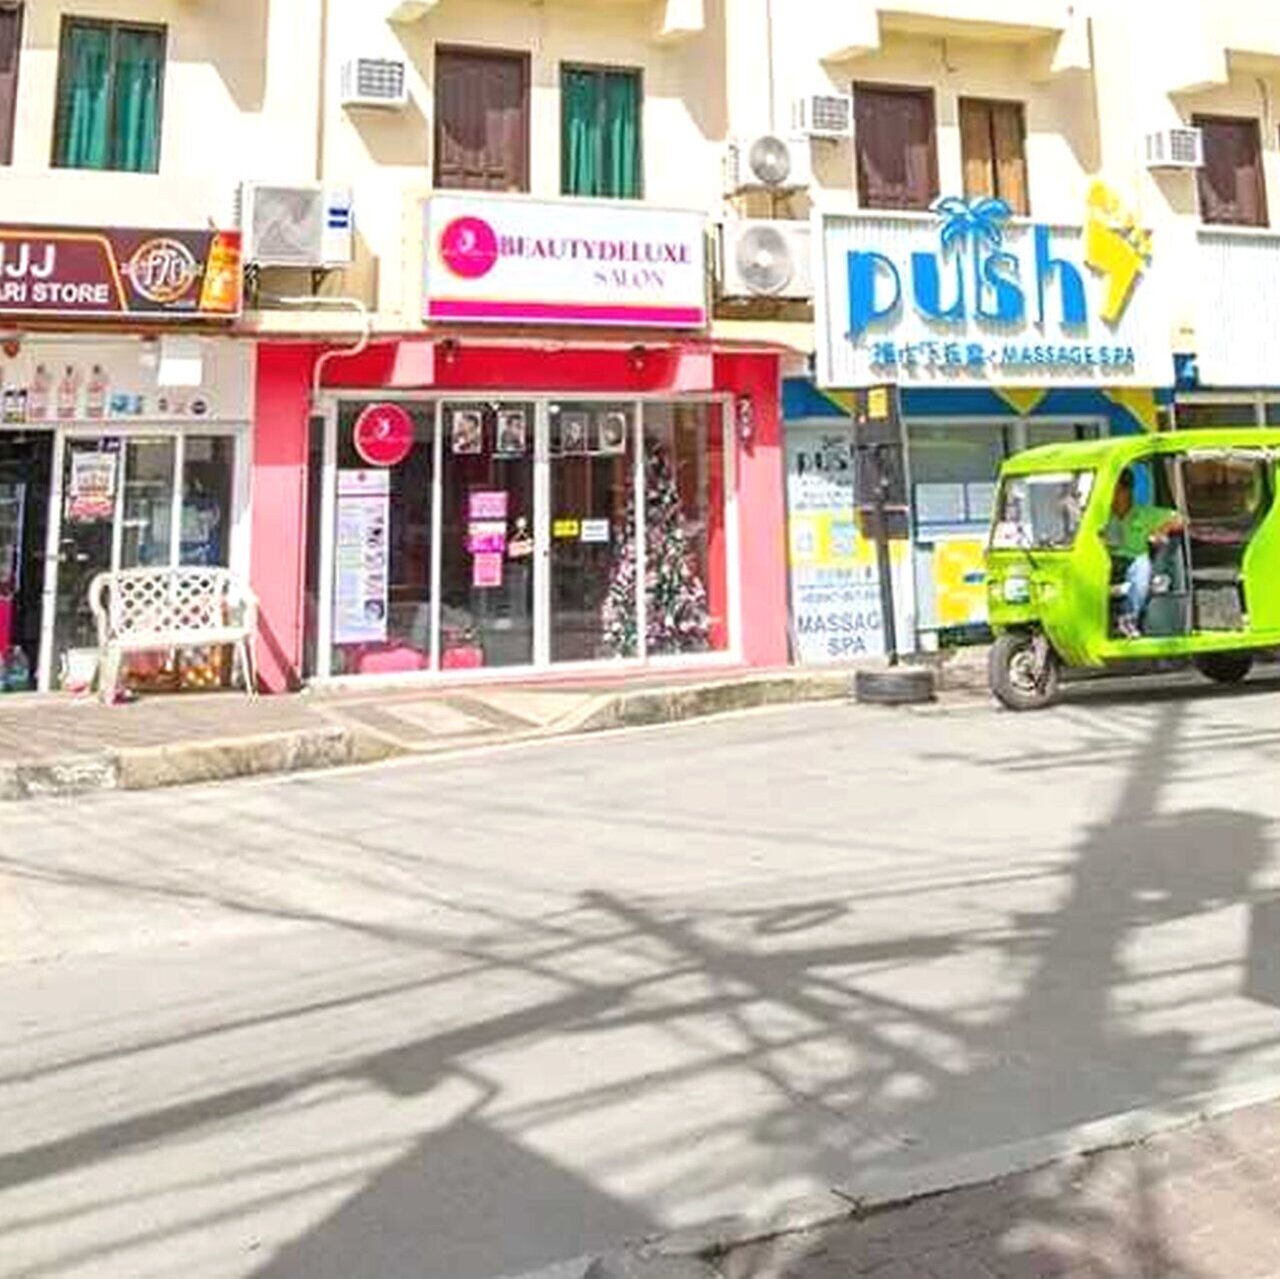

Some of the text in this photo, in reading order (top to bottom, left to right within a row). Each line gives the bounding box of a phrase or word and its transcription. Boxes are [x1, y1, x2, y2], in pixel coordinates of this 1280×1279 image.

[500, 235, 691, 264] BEAUTYDELUXE
[593, 268, 664, 288] SALON
[846, 223, 1088, 337] push
[32, 282, 109, 303] STORE
[1001, 344, 1095, 365] MASSAGE
[1099, 345, 1135, 365] SPA
[797, 451, 856, 475] pus
[798, 610, 881, 633] MASSAG
